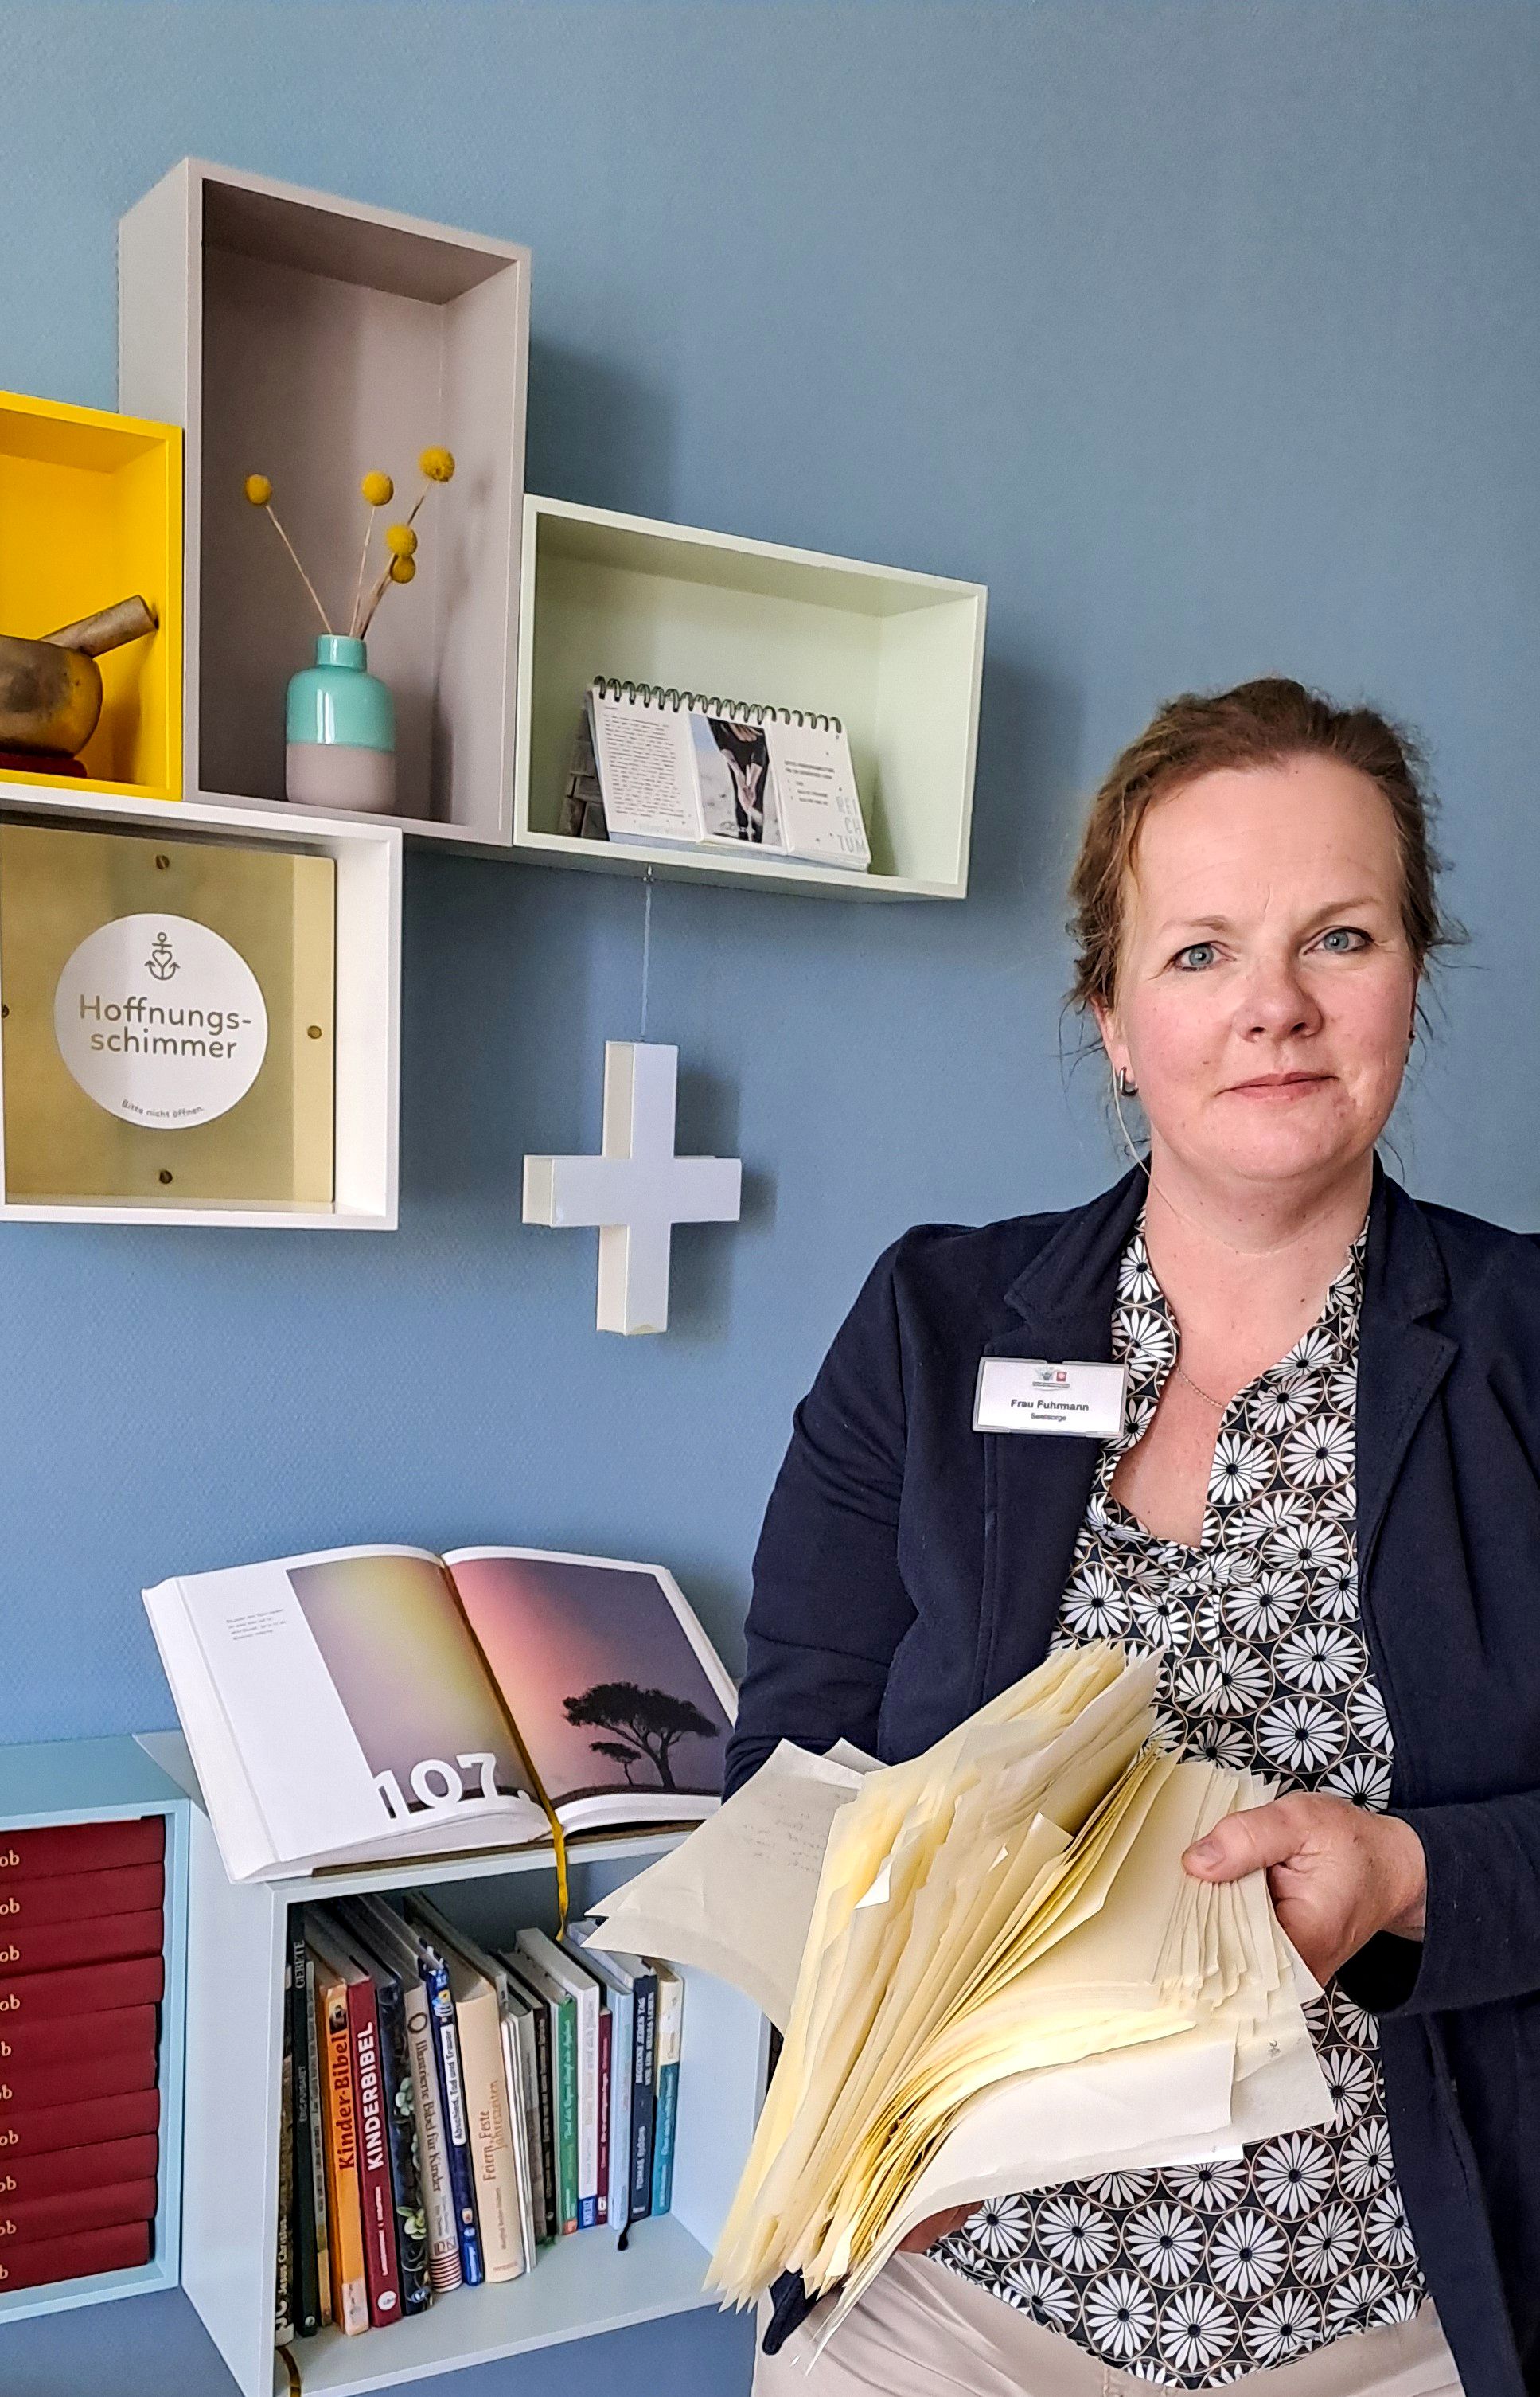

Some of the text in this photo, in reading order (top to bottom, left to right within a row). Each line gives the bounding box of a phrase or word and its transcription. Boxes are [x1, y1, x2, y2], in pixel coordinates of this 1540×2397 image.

[79, 994, 252, 1036] Hoffnungs-
[90, 1026, 238, 1060] schimmer
[122, 1099, 144, 1114] Bitte
[1010, 1399, 1090, 1411] Frau Fuhrmann
[0, 1849, 20, 1868] ob
[0, 1897, 21, 1915] ob
[0, 1944, 21, 1962] ob
[293, 1938, 306, 1989] GEBETE
[0, 1993, 21, 2012] ob
[415, 2040, 431, 2100] Illustrierte
[446, 2062, 456, 2079] und
[329, 2029, 356, 2173] Kinder-Bibel
[357, 2021, 384, 2172] KINDERBIBEL
[449, 2080, 458, 2096] Tod
[423, 2102, 438, 2132] Bibel
[478, 2110, 497, 2183] Feiern, Feste
[429, 2153, 444, 2192] Kinder
